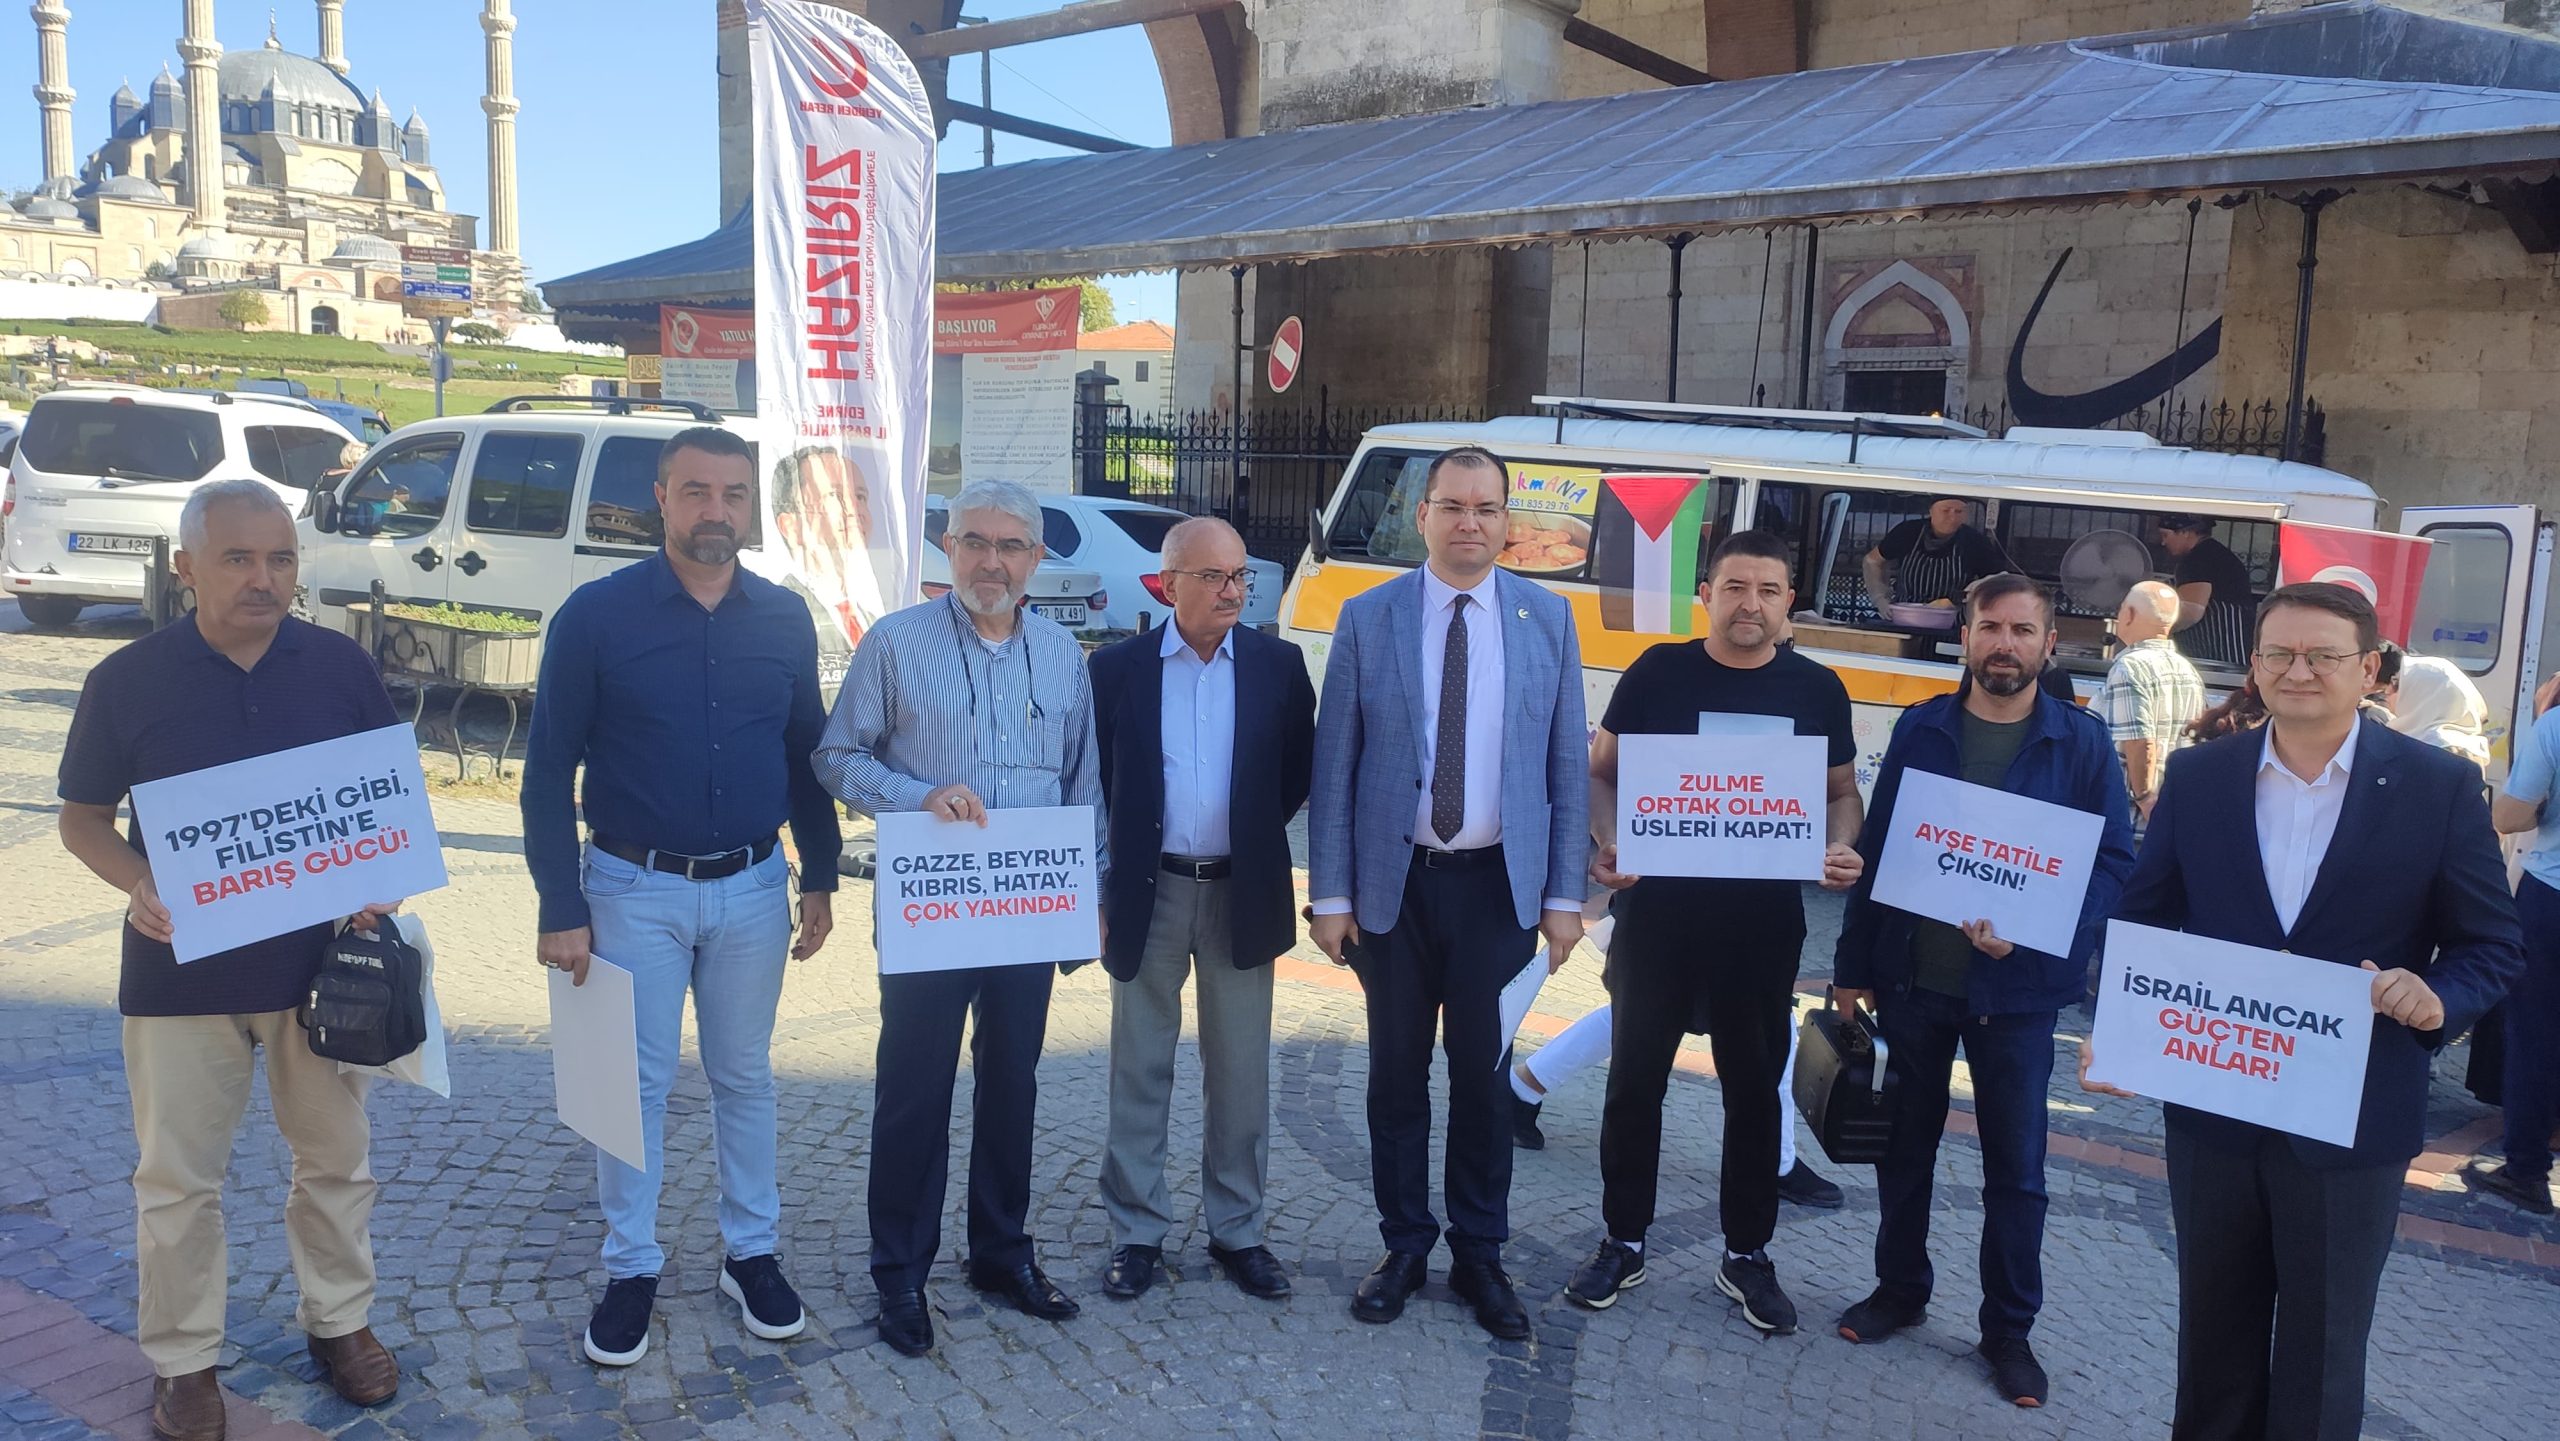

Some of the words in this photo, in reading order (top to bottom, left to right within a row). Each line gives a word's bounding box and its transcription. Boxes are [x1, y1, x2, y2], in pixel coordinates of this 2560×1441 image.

[719, 330, 748, 343] YATILI
[938, 319, 997, 336] BAŞLIYOR
[1527, 499, 1543, 509] 835
[1545, 500, 1556, 510] 29
[1559, 502, 1570, 511] 76
[78, 537, 94, 549] 22
[103, 538, 121, 550] LK
[128, 540, 151, 552] 125
[1054, 607, 1065, 620] DK
[1068, 606, 1083, 620] 491
[1679, 774, 1765, 793] ZULME
[164, 787, 327, 852] 1997'DEKİ
[335, 768, 410, 808] GİBİ,
[1636, 796, 1721, 815] ORTAK
[1728, 797, 1807, 819] OLMA,
[215, 809, 378, 870] FİLİSTİN'E
[1631, 814, 1716, 838] ÜSLERİ
[1724, 821, 1811, 840] KAPAT!
[892, 853, 981, 874] GAZZE,
[988, 848, 1085, 869] BEYRUT,
[1915, 822, 1977, 854] AYŞE
[1982, 837, 2063, 876] TATİLE
[192, 860, 297, 906] BARIŞ
[304, 825, 410, 874] GÜCÜ!
[1937, 852, 2027, 891] ÇIKSIN!
[900, 876, 988, 898] KIBRIS,
[994, 871, 1079, 892] HATAY..
[903, 902, 960, 928] ÇOK
[965, 894, 1076, 918] YAKINDA!
[2123, 966, 2220, 1012] İSRAİL
[2225, 995, 2344, 1039] ANCAK
[2158, 1007, 2296, 1057] GÜÇTEN
[2162, 1037, 2281, 1082] ANLAR!
